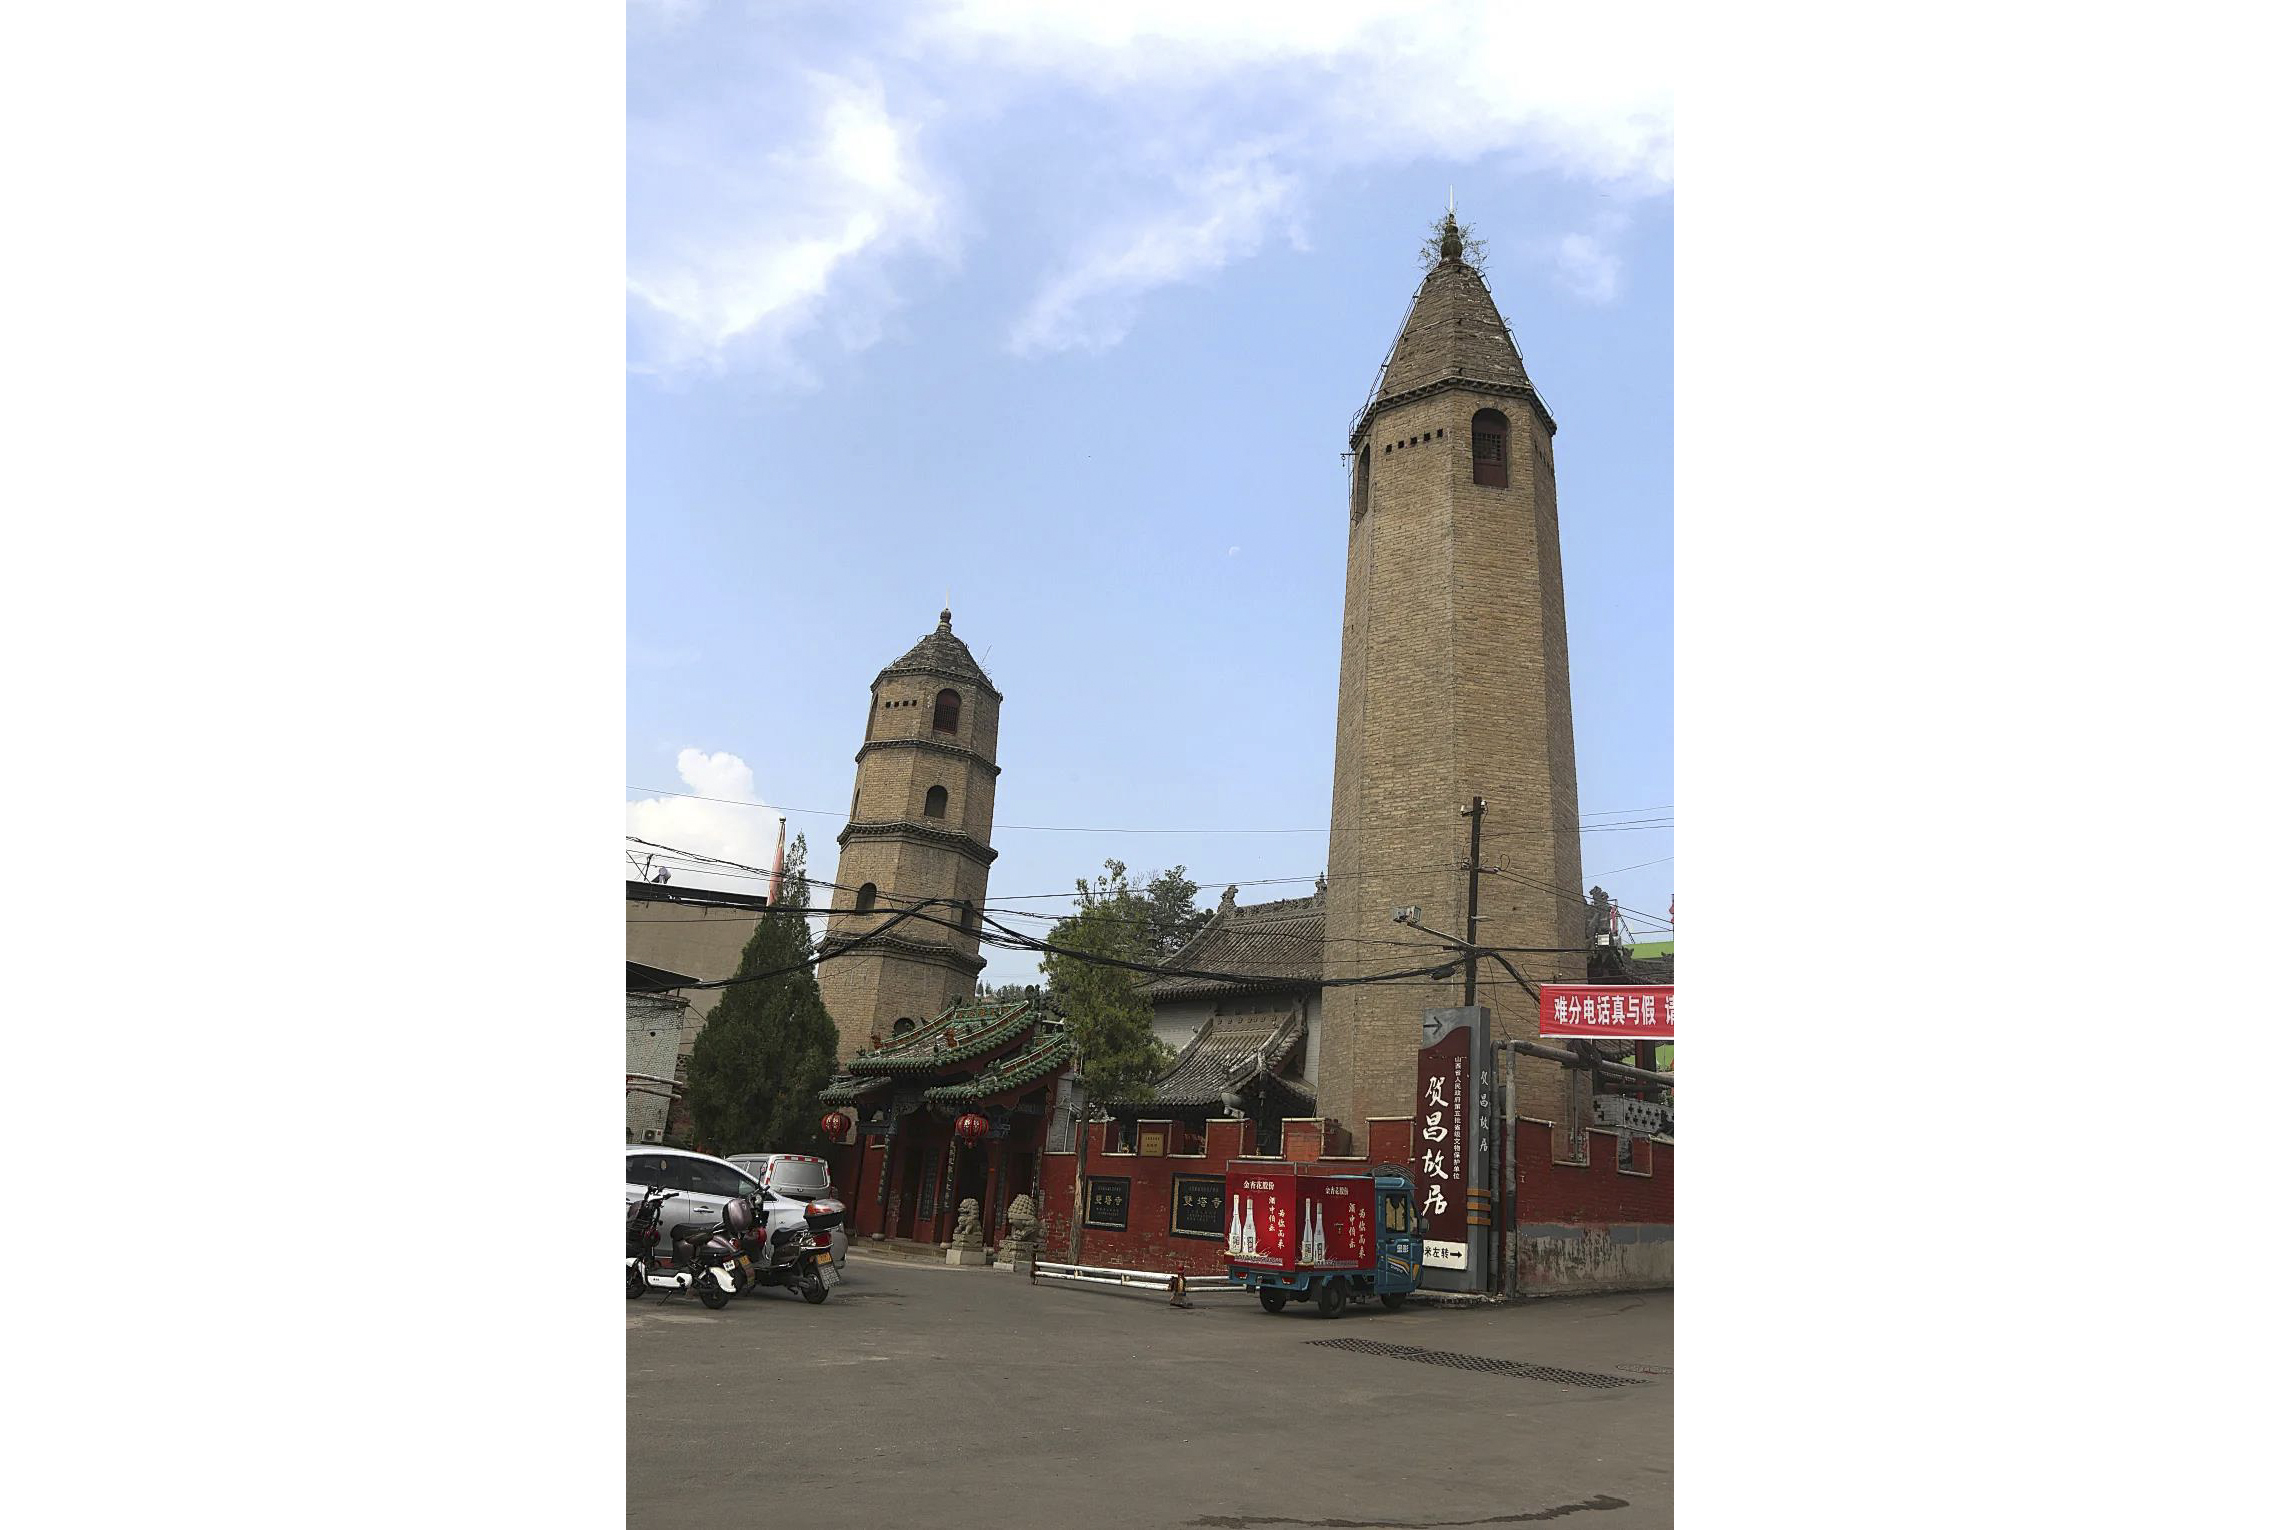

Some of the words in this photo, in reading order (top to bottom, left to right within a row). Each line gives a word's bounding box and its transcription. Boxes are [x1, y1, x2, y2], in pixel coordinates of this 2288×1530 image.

[1554, 995, 1656, 1025] 难分电话真与假
[1453, 1056, 1462, 1180] 山西省人民政府第五批省级文物保护单位
[1480, 1070, 1489, 1152] 贺昌故居
[1421, 1076, 1449, 1216] 贺昌故居
[1182, 1195, 1222, 1209] 雙塔寺
[1424, 1246, 1449, 1259] 米左转
